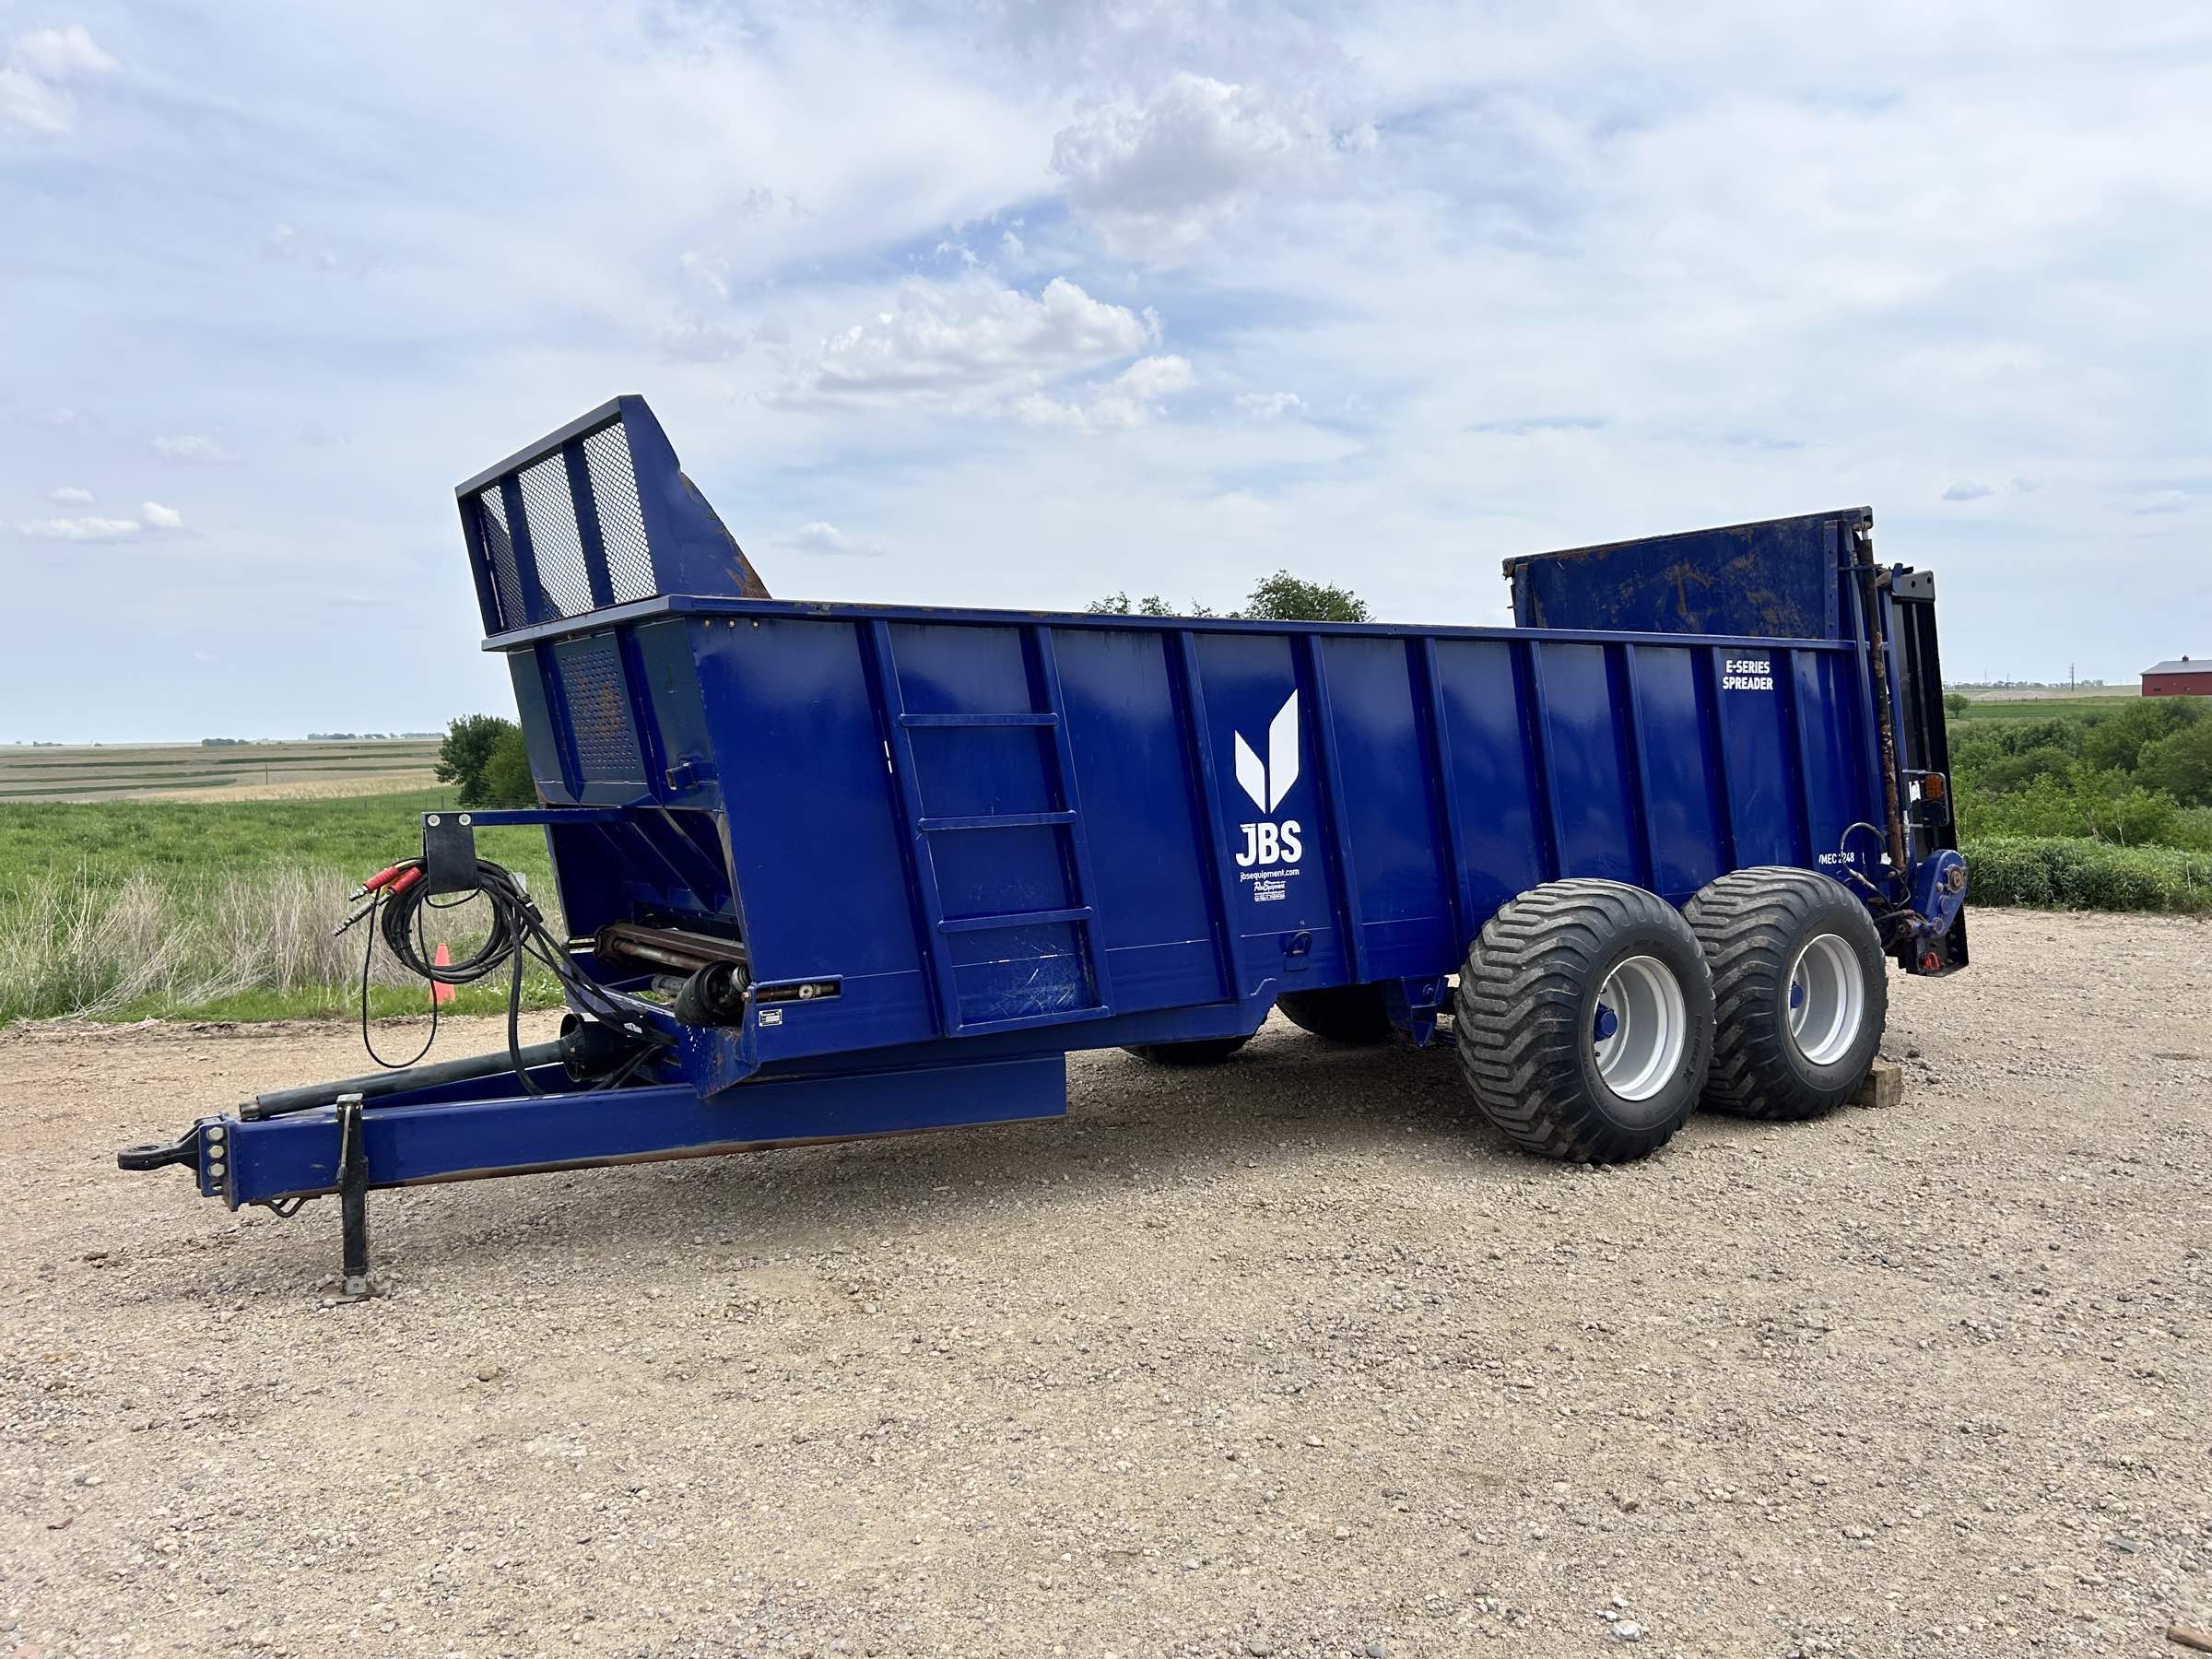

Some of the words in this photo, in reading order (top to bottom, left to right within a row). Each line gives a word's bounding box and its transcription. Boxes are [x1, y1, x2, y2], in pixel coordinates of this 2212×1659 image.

[1726, 660, 1770, 674] E-SERIES
[1723, 677, 1773, 689] SPREADER
[1236, 820, 1302, 866] JBS
[1240, 869, 1300, 882] jbsequipment.com
